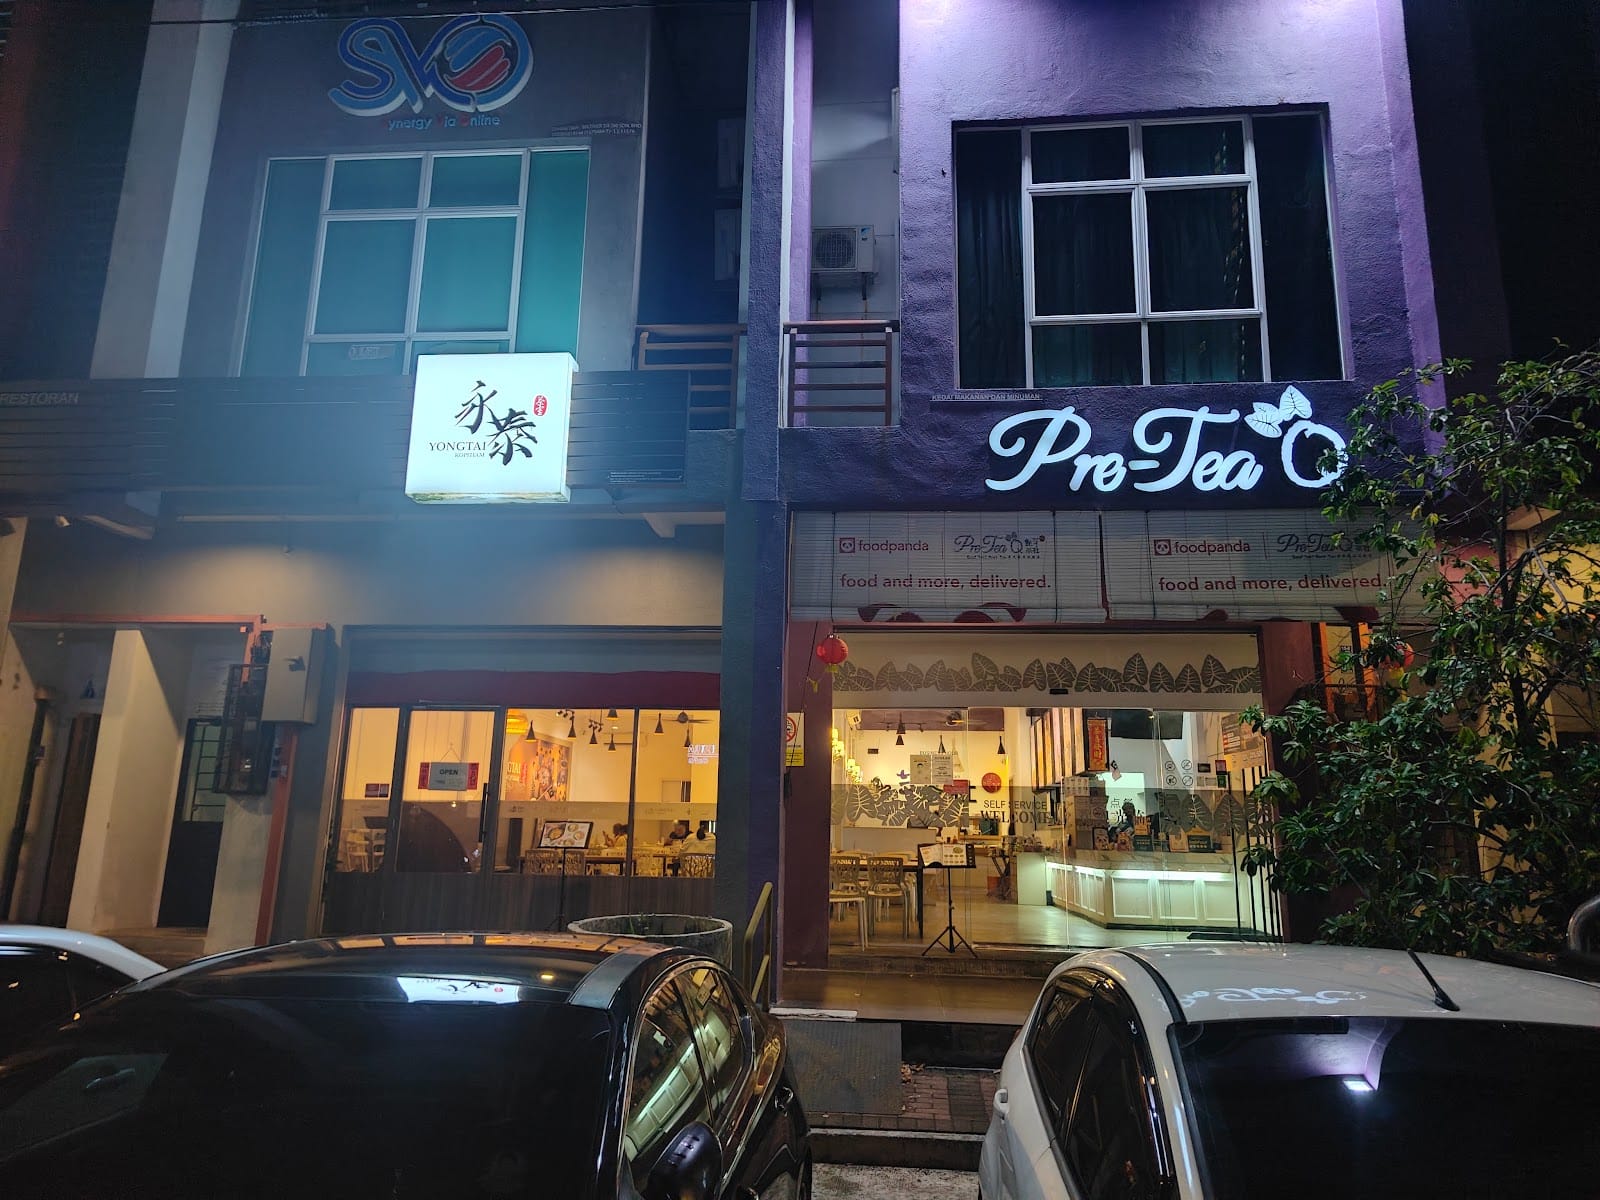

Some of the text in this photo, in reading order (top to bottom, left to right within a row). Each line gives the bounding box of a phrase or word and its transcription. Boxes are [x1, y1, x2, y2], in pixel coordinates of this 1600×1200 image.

[429, 441, 486, 452] YONGTAI
[984, 406, 1263, 492] Pre-Tea
[858, 539, 929, 554] foodpanda
[1175, 540, 1250, 556] foodpanda
[840, 574, 1051, 590] food and more, delivered.
[1158, 573, 1387, 591] food and more, delivered.
[983, 800, 1047, 810] SELF SERVICE
[980, 810, 1052, 824] WELCOME
